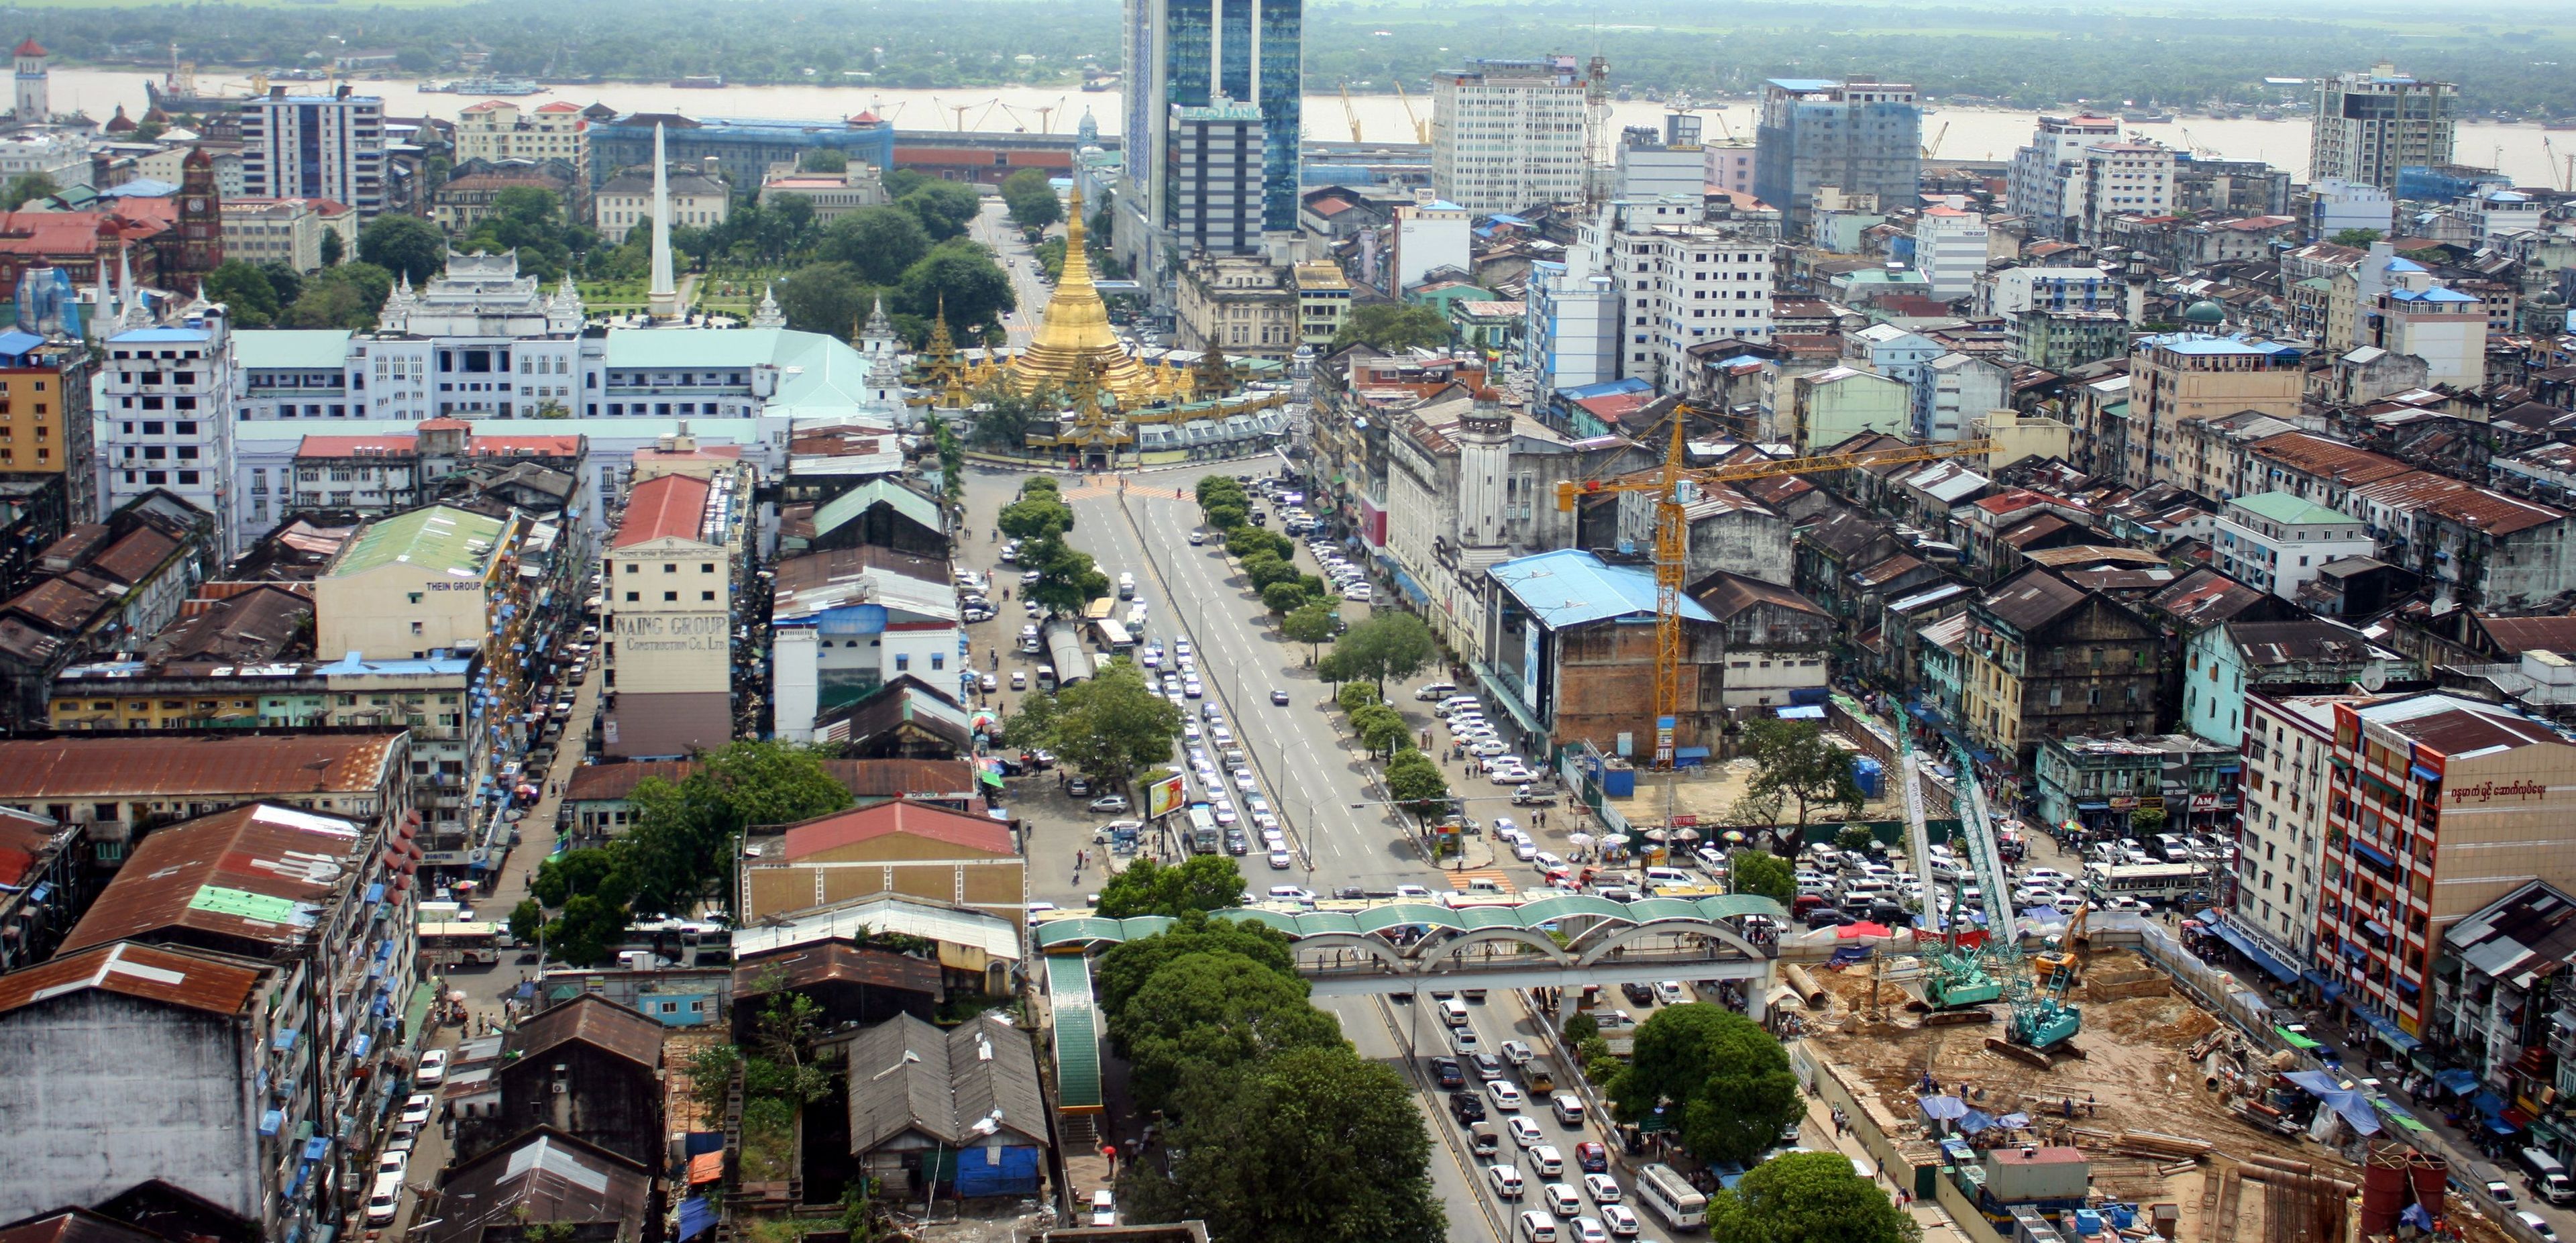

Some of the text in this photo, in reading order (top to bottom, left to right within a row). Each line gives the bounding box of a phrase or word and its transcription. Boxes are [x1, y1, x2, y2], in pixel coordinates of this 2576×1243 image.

[1224, 107, 1259, 118] BANK
[427, 582, 481, 590] THEIN GROUP
[616, 617, 726, 635] NAING GROUP
[2241, 926, 2257, 942] CENTRE
[2275, 951, 2298, 971] FASHION
